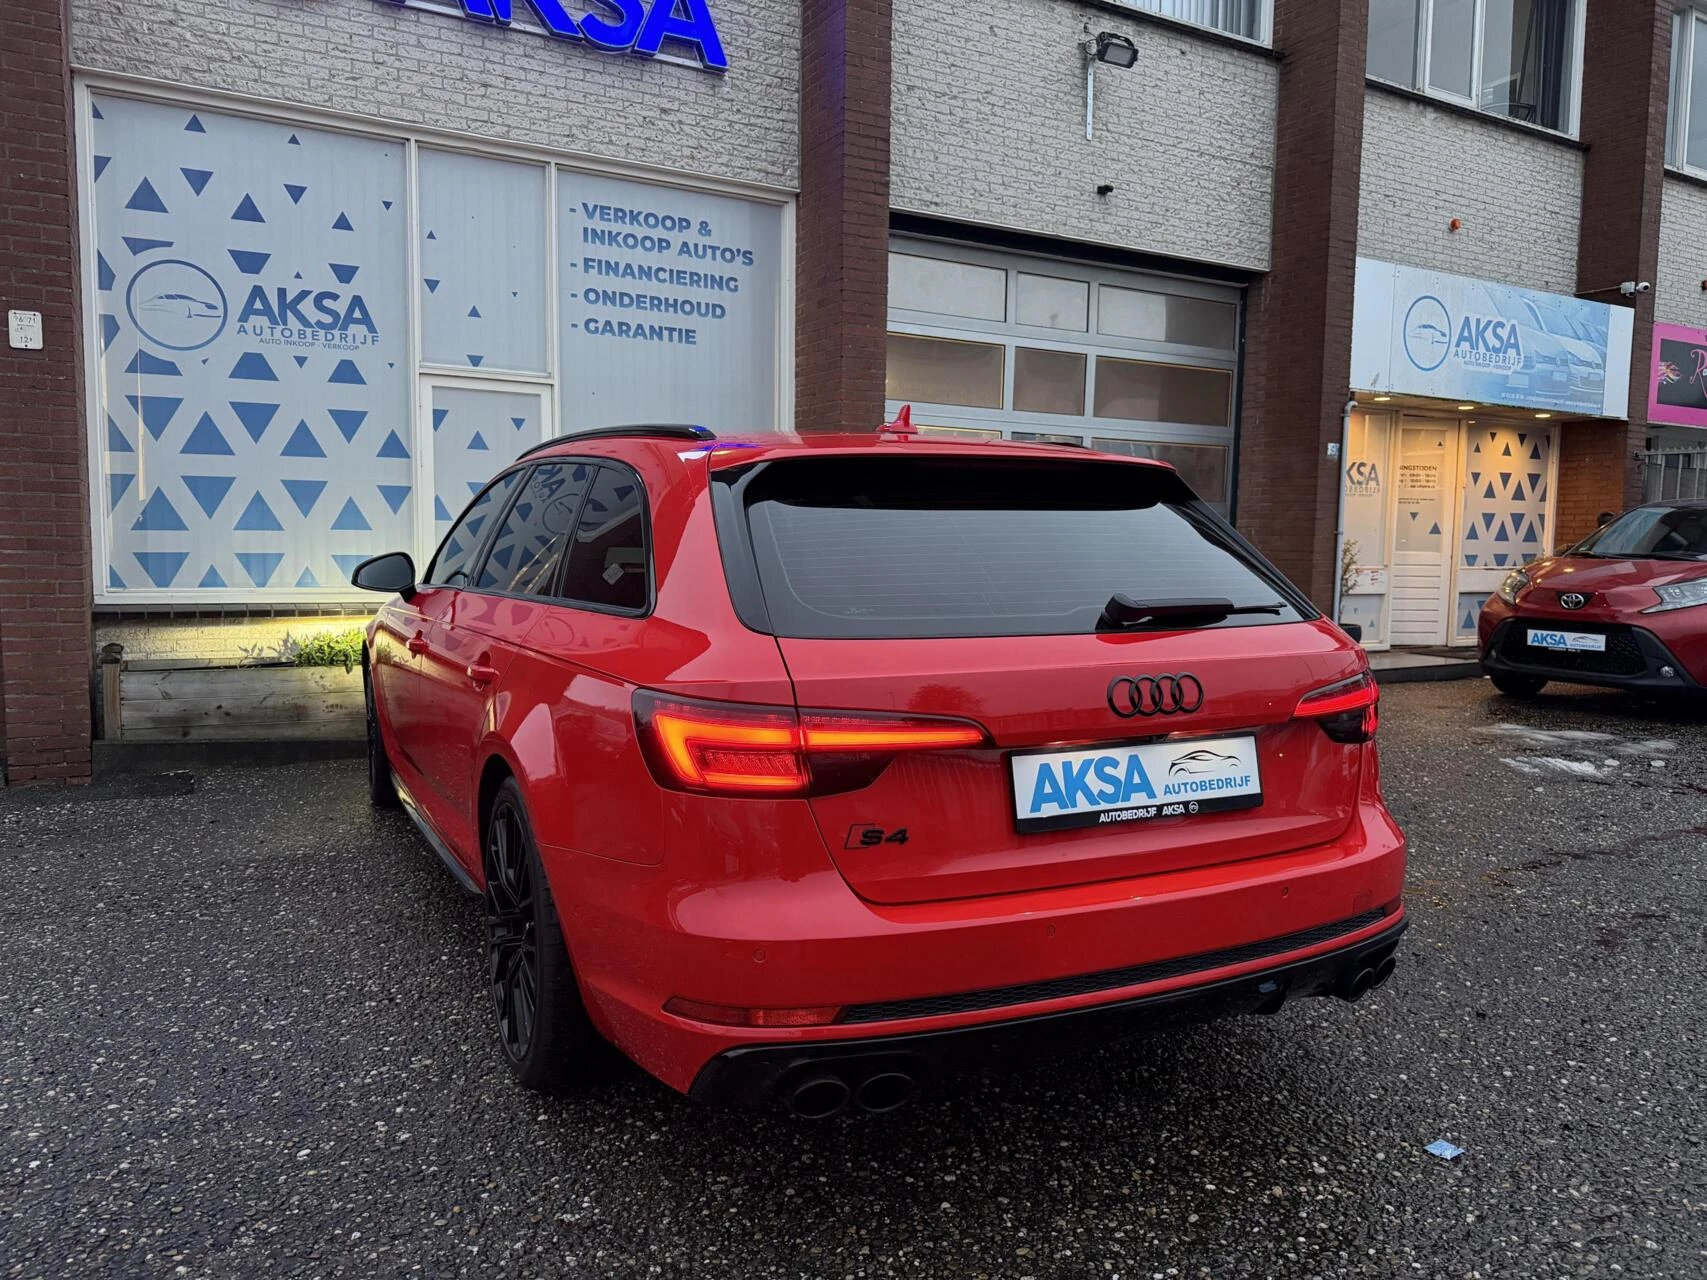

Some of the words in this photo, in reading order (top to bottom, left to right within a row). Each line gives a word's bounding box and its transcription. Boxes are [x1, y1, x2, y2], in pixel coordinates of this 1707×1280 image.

[582, 202, 691, 233] VERKOOP
[697, 220, 712, 237] &
[583, 227, 671, 253] INKOOP
[677, 241, 754, 266] AUTO'S
[583, 257, 739, 293] FINANCIERING
[237, 285, 378, 334] AKSA
[583, 288, 726, 319] ONDERHOUD
[236, 324, 379, 346] AUTOBEDRIJF
[259, 337, 281, 345] AUTO
[284, 340, 315, 348] INKOOP
[323, 343, 360, 351] VERKOOP
[584, 318, 697, 345] GARANTIE
[1455, 316, 1521, 356] AKSA
[1453, 349, 1522, 368] AUTOBEDRIJF
[1531, 632, 1568, 647] AKSA
[1029, 754, 1157, 814] AKSA
[1163, 775, 1251, 796] AUTOBEDRIJF
[1099, 809, 1158, 823] AUTOBEDRIJF
[1162, 804, 1185, 816] AKSA
[859, 828, 909, 846] S4
